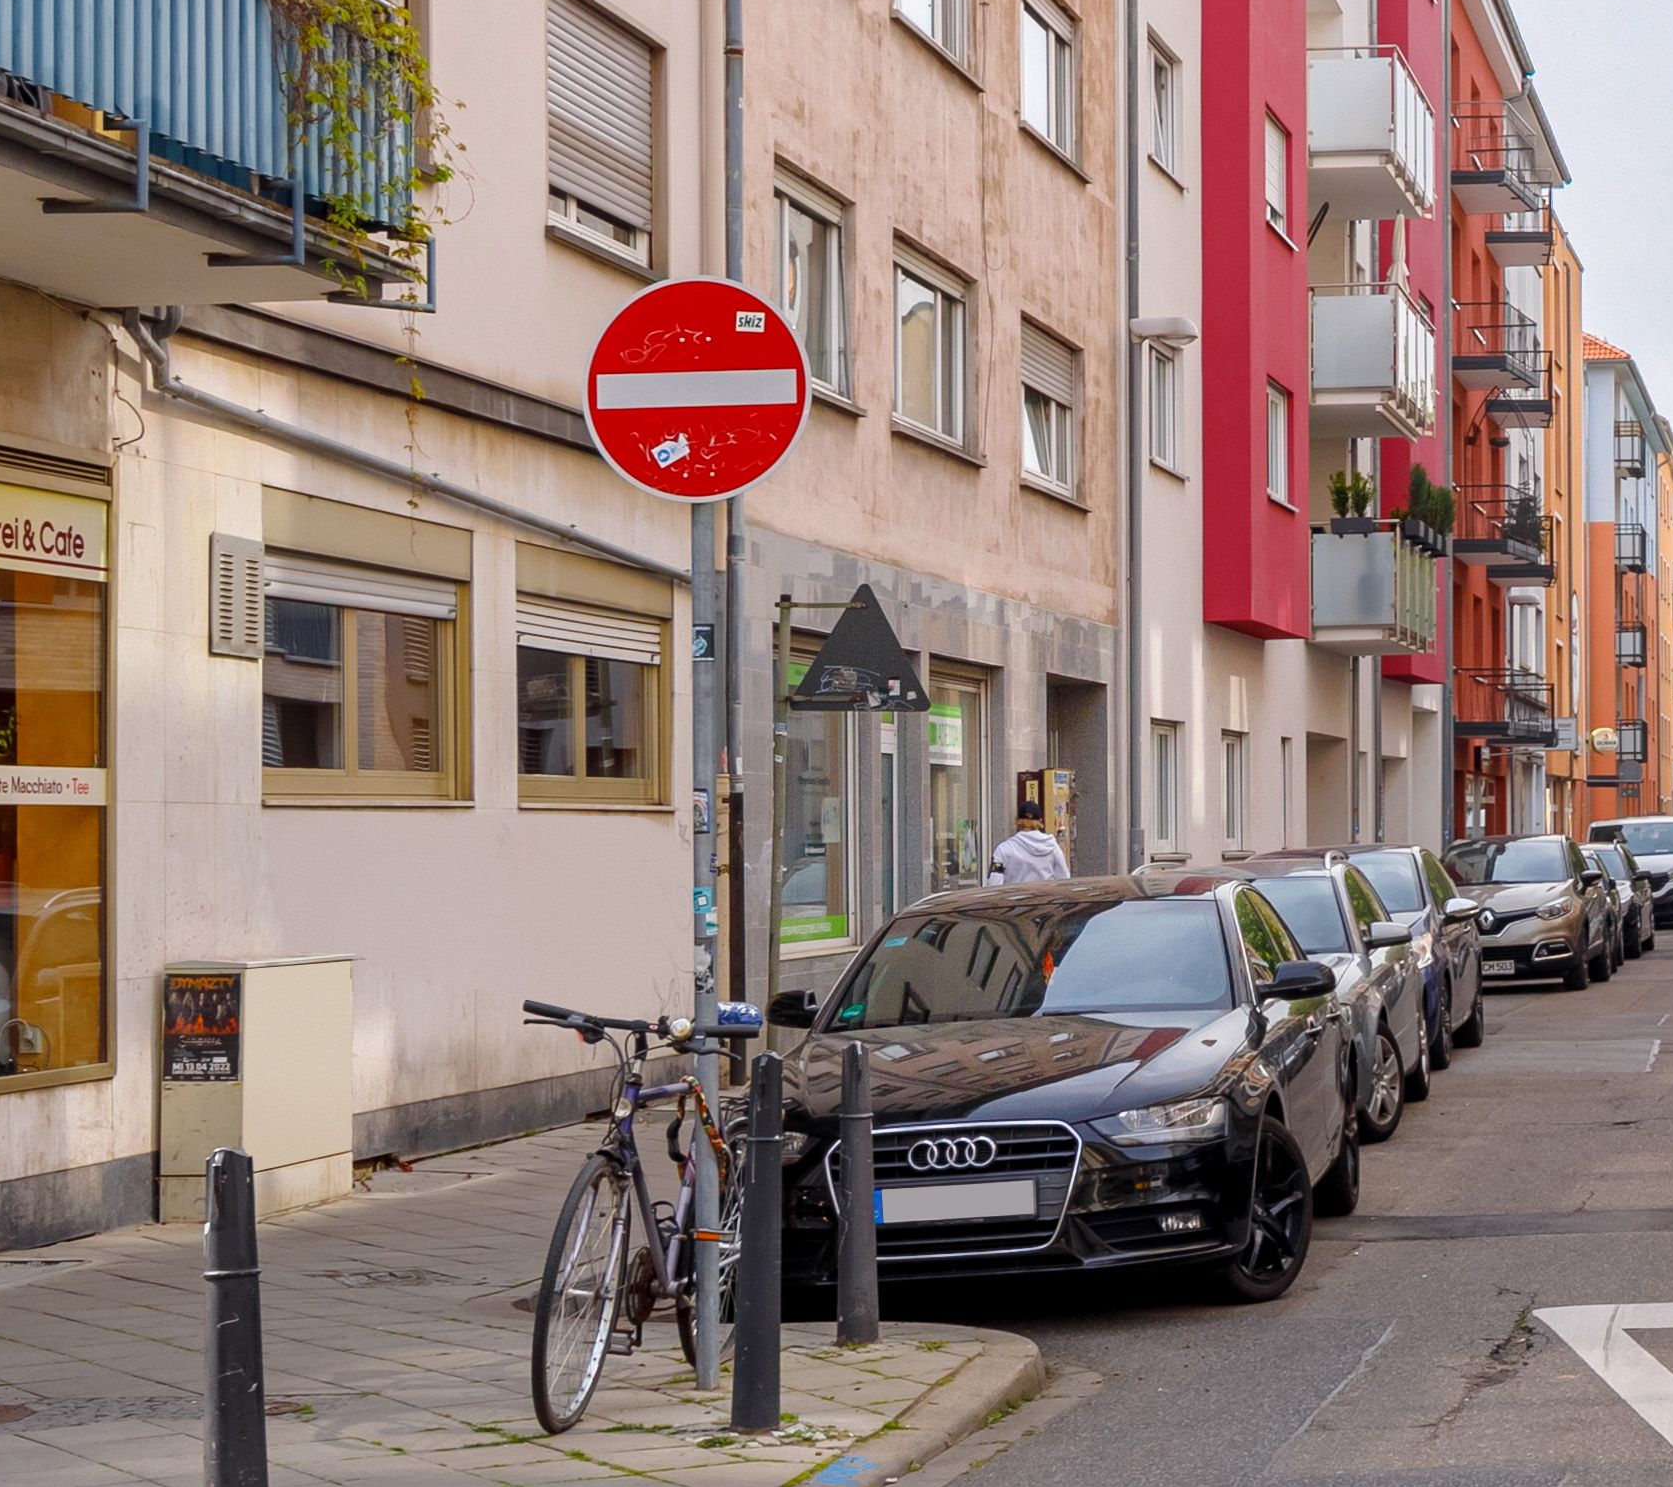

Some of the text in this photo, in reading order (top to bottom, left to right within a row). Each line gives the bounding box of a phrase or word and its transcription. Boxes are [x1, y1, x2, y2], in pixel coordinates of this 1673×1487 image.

[738, 314, 763, 329] skiz
[22, 519, 36, 552] &
[39, 521, 84, 559] Cafe
[11, 777, 63, 794] Macchiato
[72, 778, 90, 795] Tee
